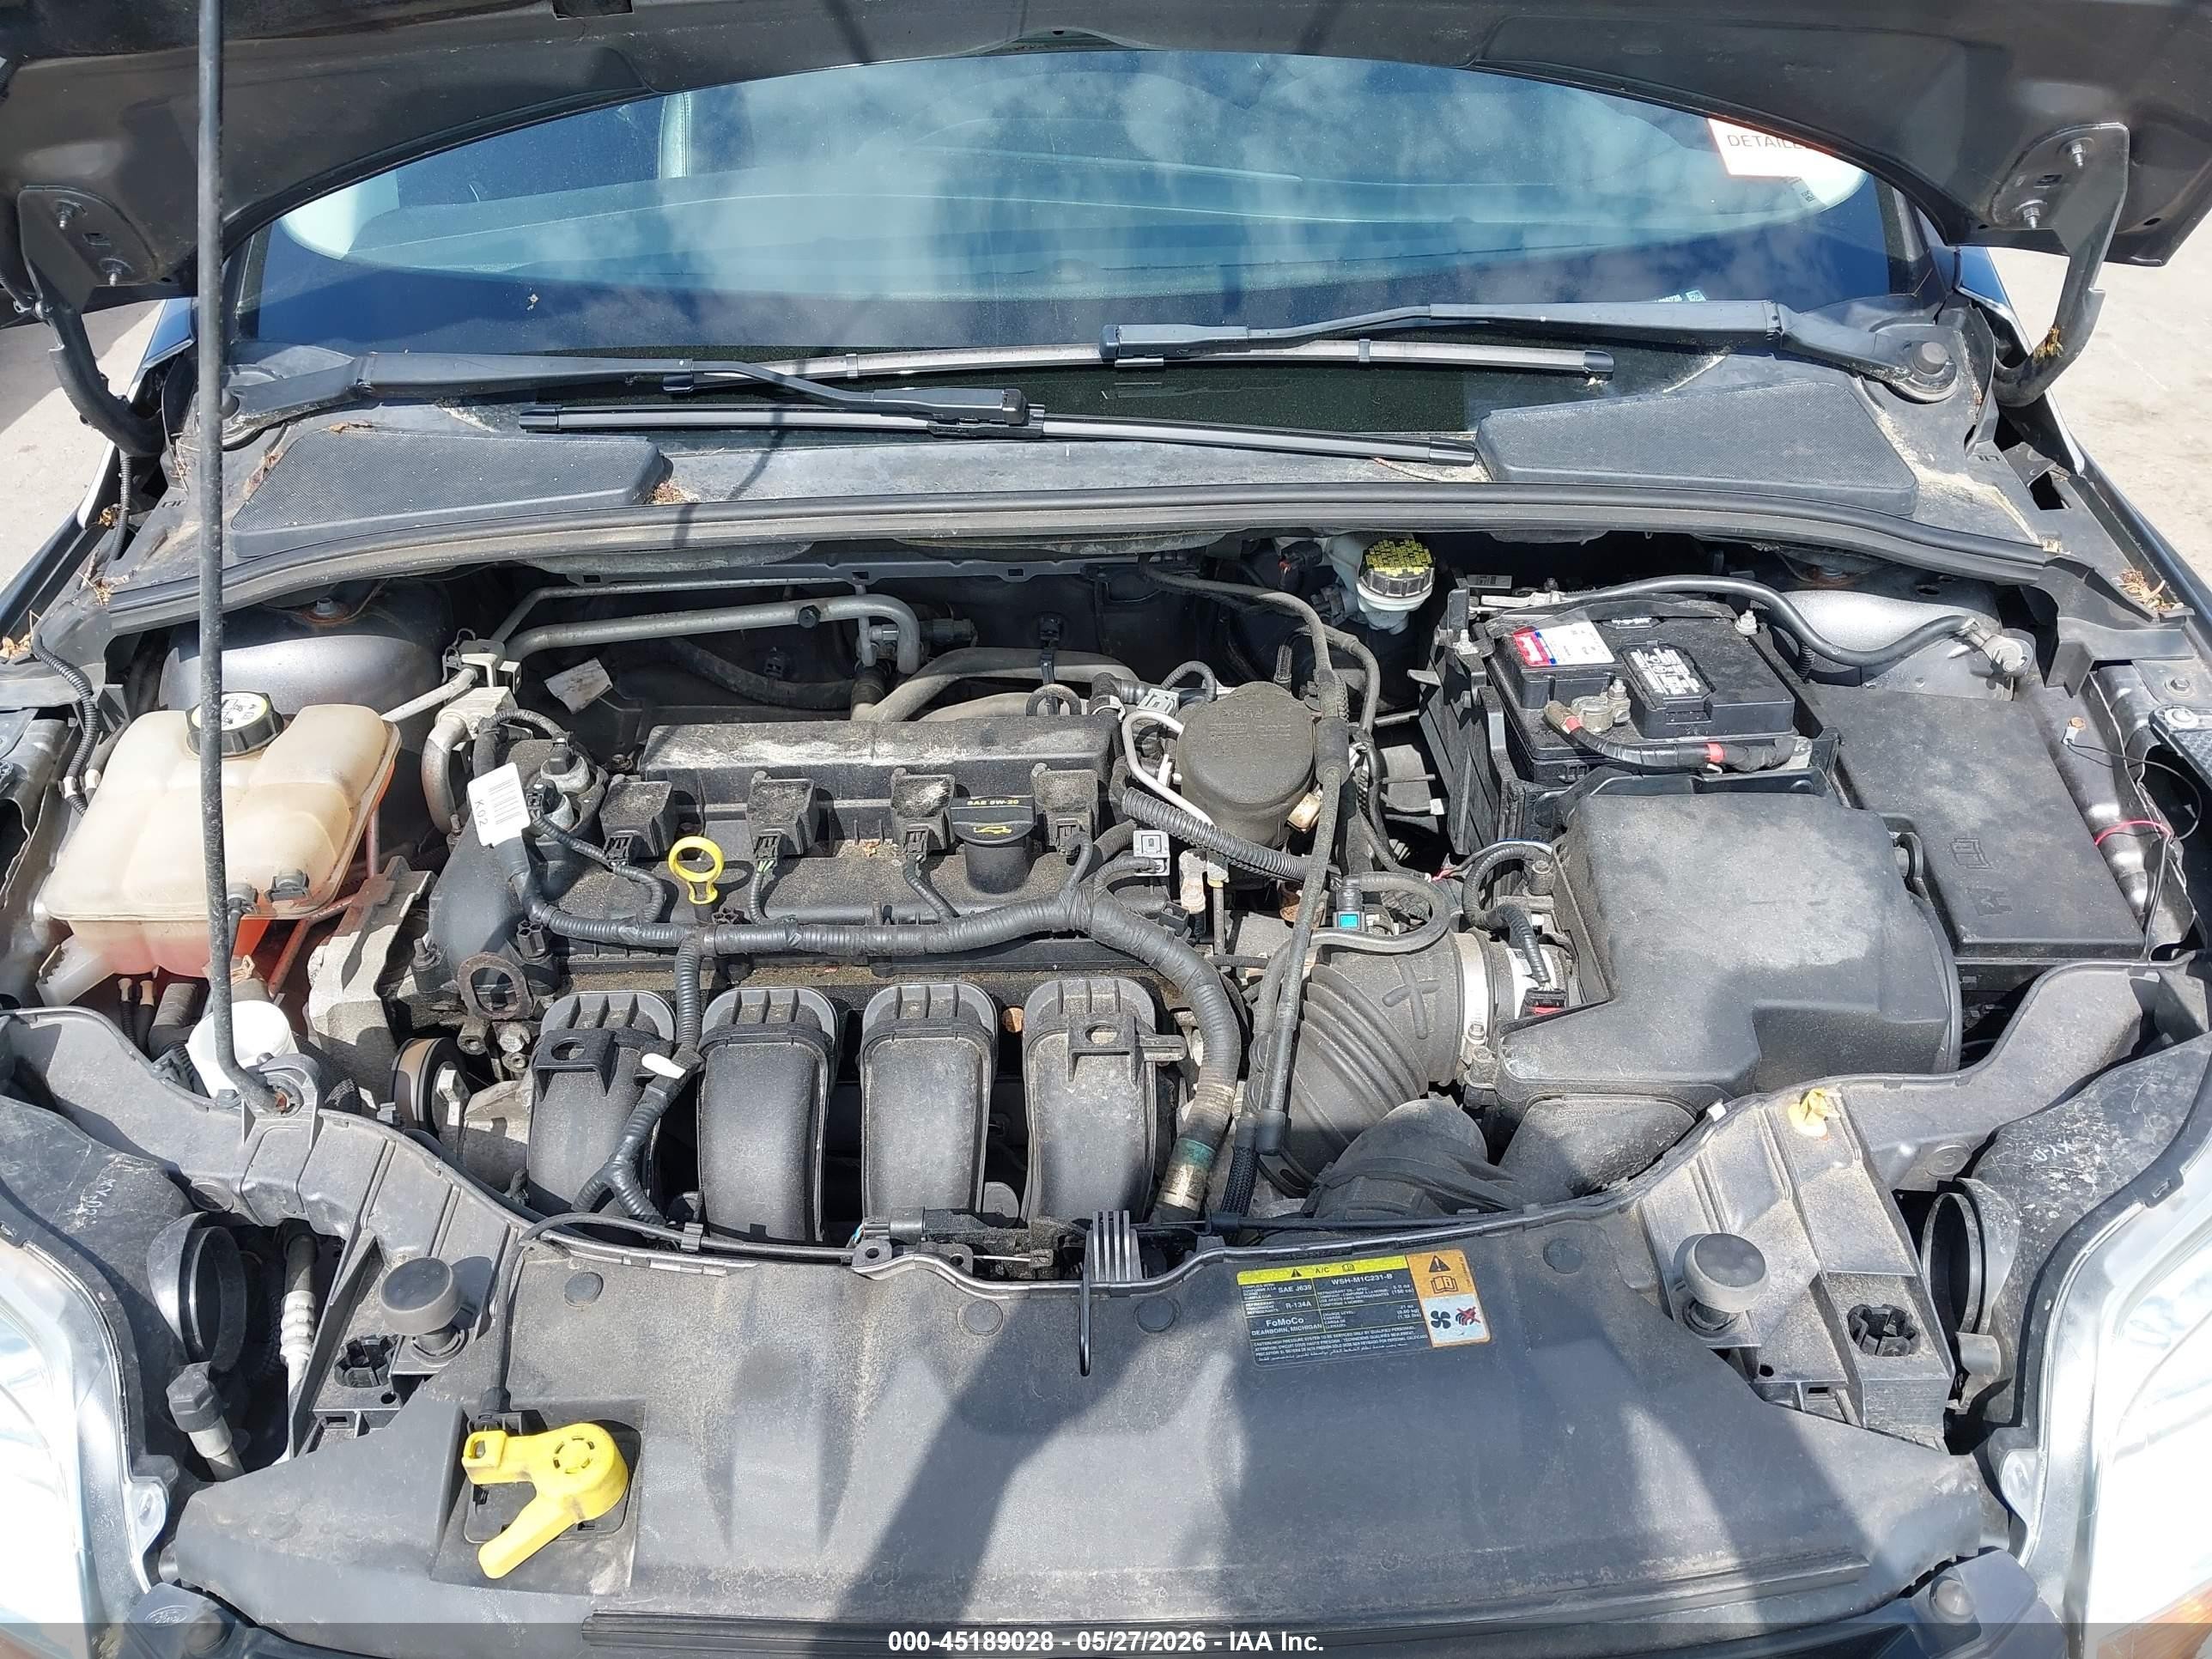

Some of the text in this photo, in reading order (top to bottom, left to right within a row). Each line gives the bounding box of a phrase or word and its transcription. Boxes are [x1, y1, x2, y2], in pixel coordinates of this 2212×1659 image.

[1331, 1273, 1393, 1285] WSH-M1C231-B
[1266, 1316, 1304, 1328] FoMoCo
[1251, 1328, 1290, 1336] DEARBORN,
[1291, 1323, 1322, 1332] MICHIGAN
